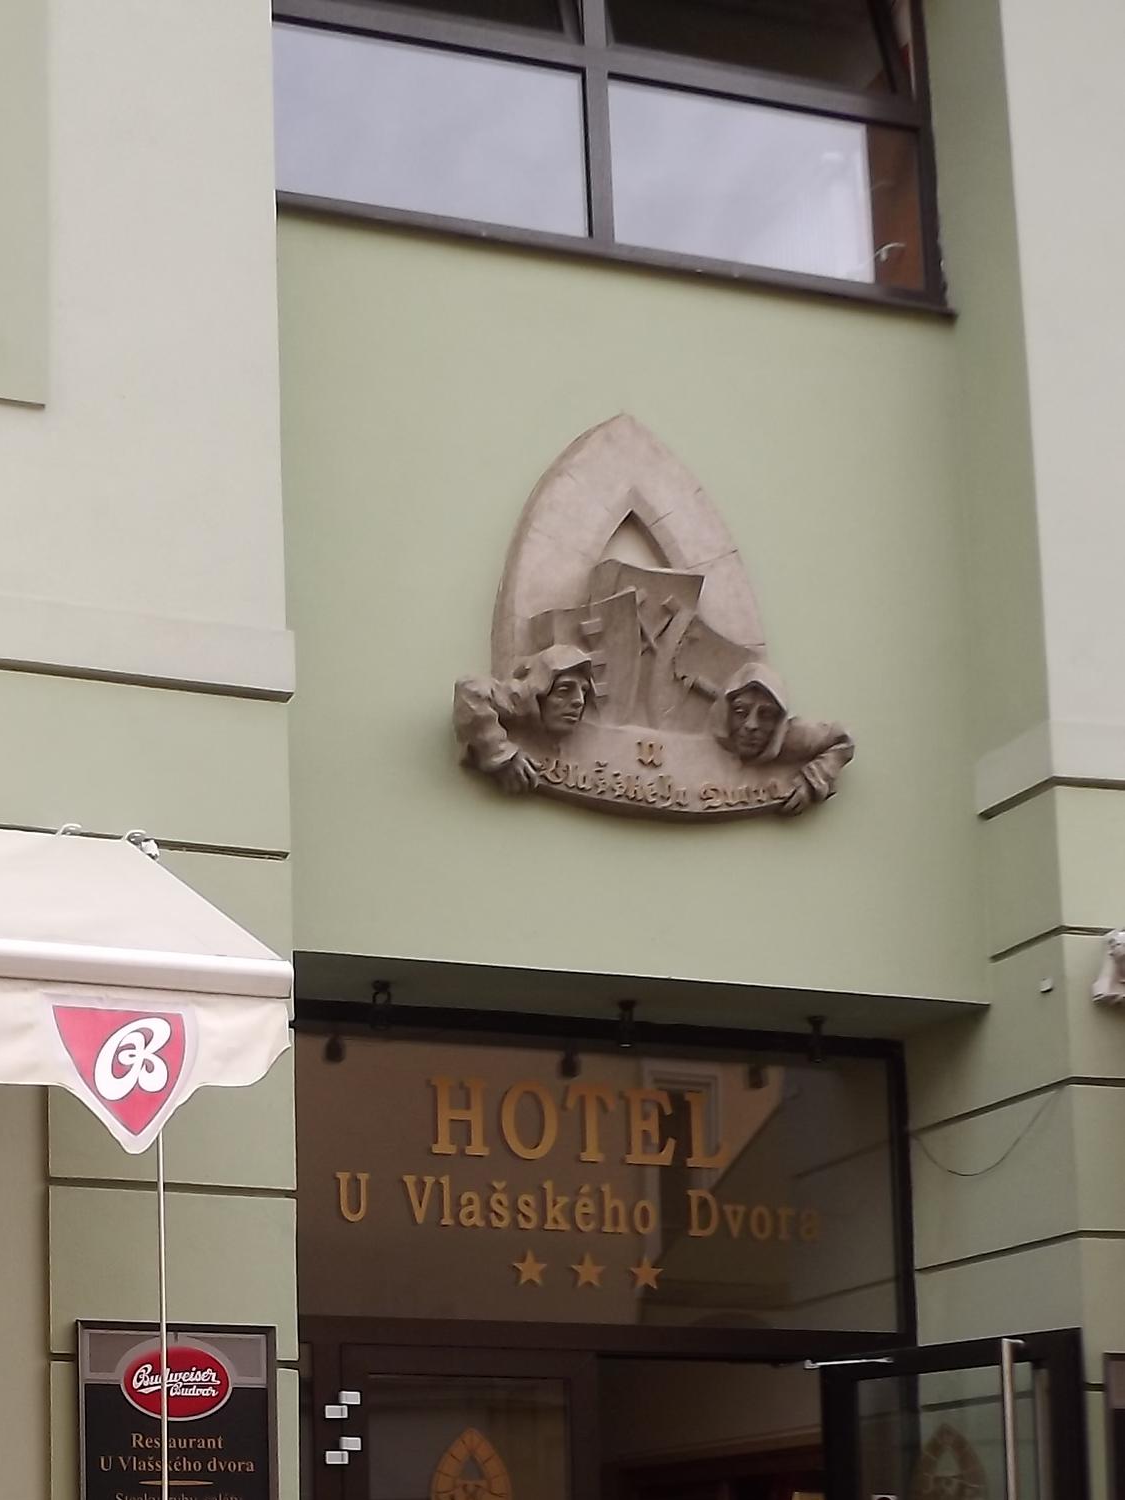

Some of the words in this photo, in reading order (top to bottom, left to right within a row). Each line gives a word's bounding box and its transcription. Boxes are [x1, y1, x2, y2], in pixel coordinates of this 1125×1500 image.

[430, 1076, 732, 1169] HOTEL
[335, 1171, 370, 1223] U
[403, 1174, 659, 1236] Vlašského
[686, 1188, 825, 1243] Dvora
[131, 1432, 223, 1450] Resaurant
[99, 1455, 113, 1472] U
[207, 1456, 255, 1473] dvora
